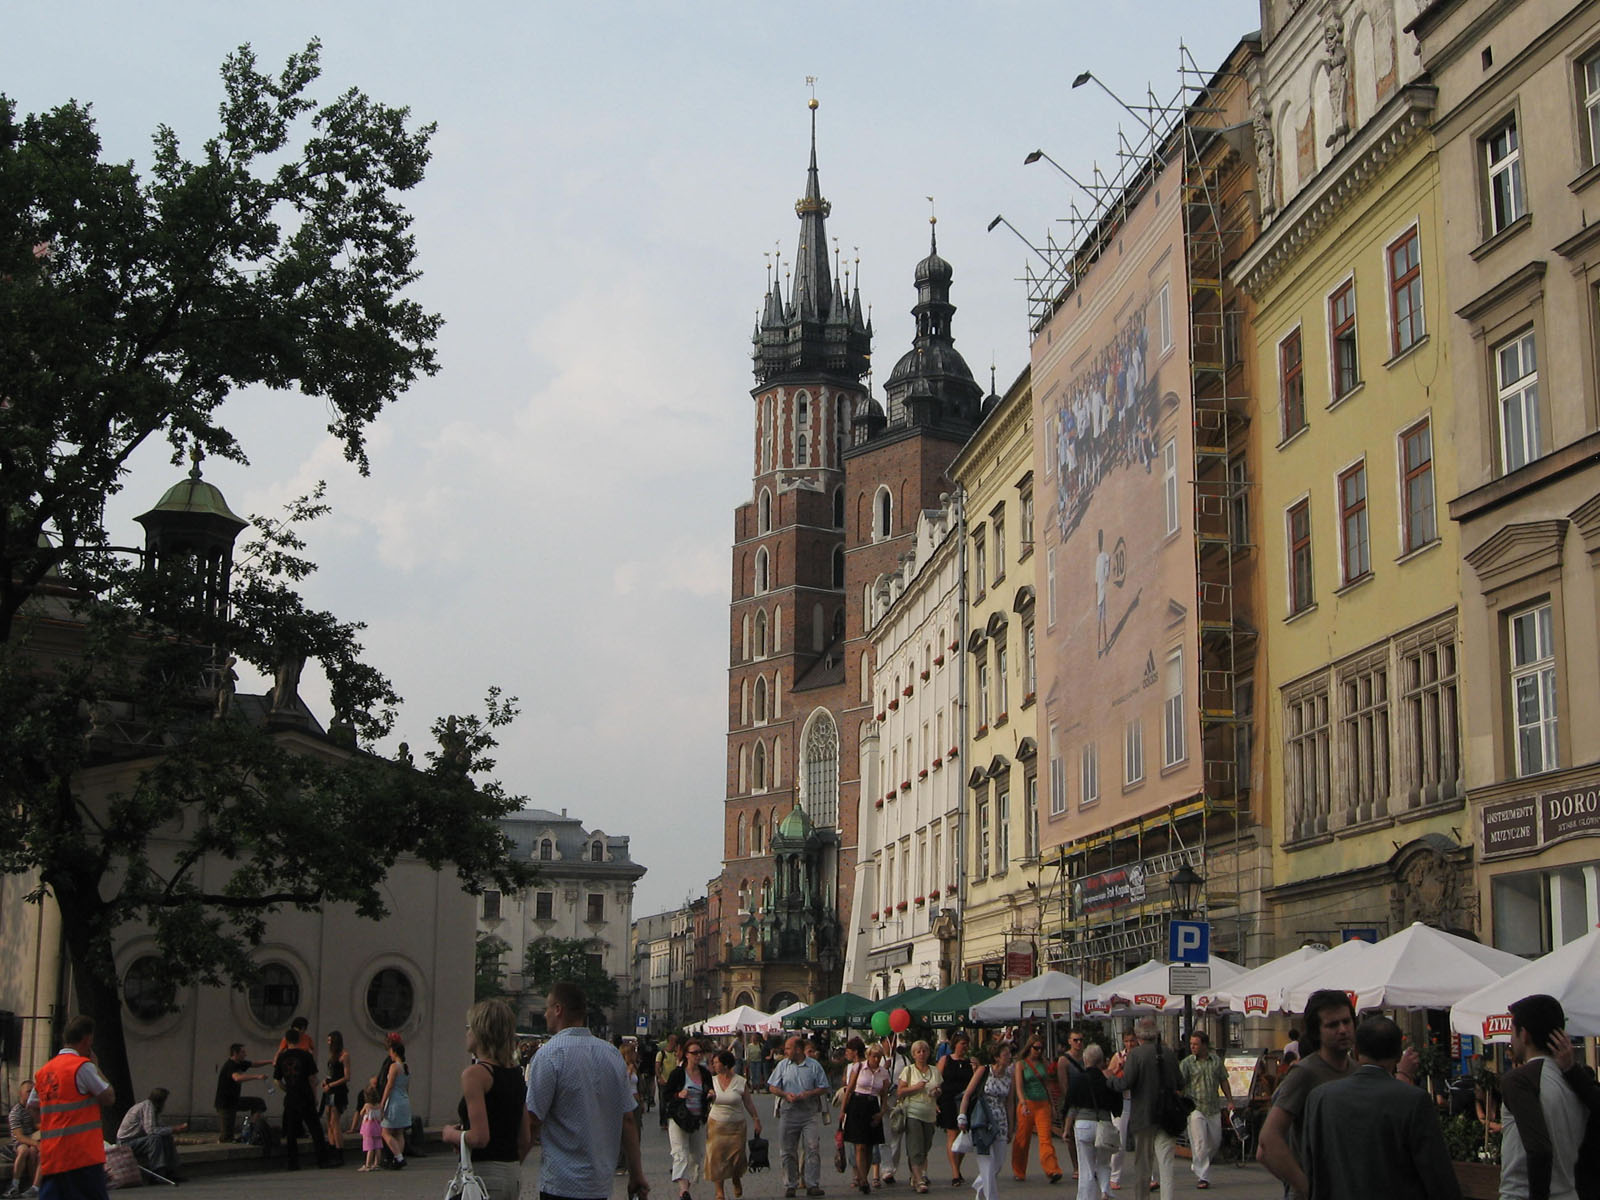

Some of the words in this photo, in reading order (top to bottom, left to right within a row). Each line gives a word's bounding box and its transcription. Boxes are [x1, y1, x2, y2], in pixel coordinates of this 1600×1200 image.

[1549, 791, 1600, 821] DORO
[1490, 826, 1531, 843] MUZYCZNE
[1177, 925, 1201, 958] P
[638, 1016, 646, 1026] P
[933, 1014, 953, 1022] LECH
[708, 1025, 729, 1033] TYSKIE
